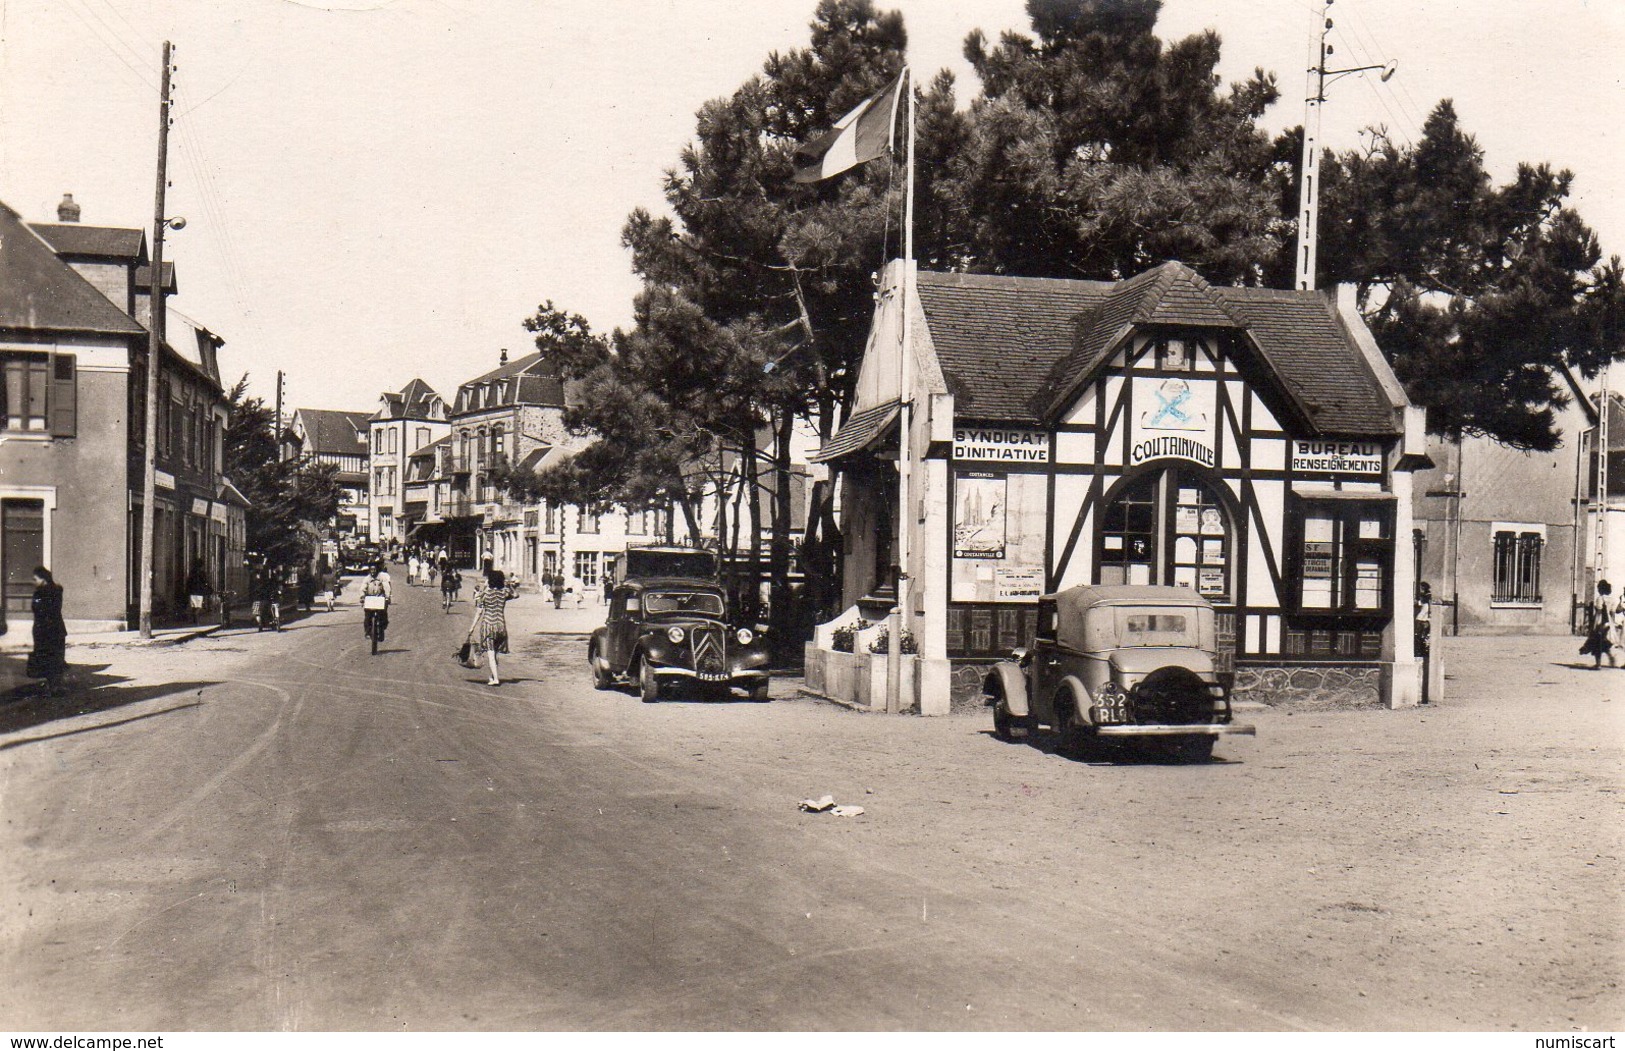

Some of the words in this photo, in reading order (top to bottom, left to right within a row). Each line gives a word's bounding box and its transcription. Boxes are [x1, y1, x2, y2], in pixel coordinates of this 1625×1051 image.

[955, 430, 1045, 445] SYNDICAT
[955, 445, 1047, 460] D'INITIATIVE
[1132, 437, 1214, 466] COUTAINVILLE
[1299, 443, 1374, 456] BUREAU
[1293, 458, 1381, 472] RENSEIGNEMENTS
